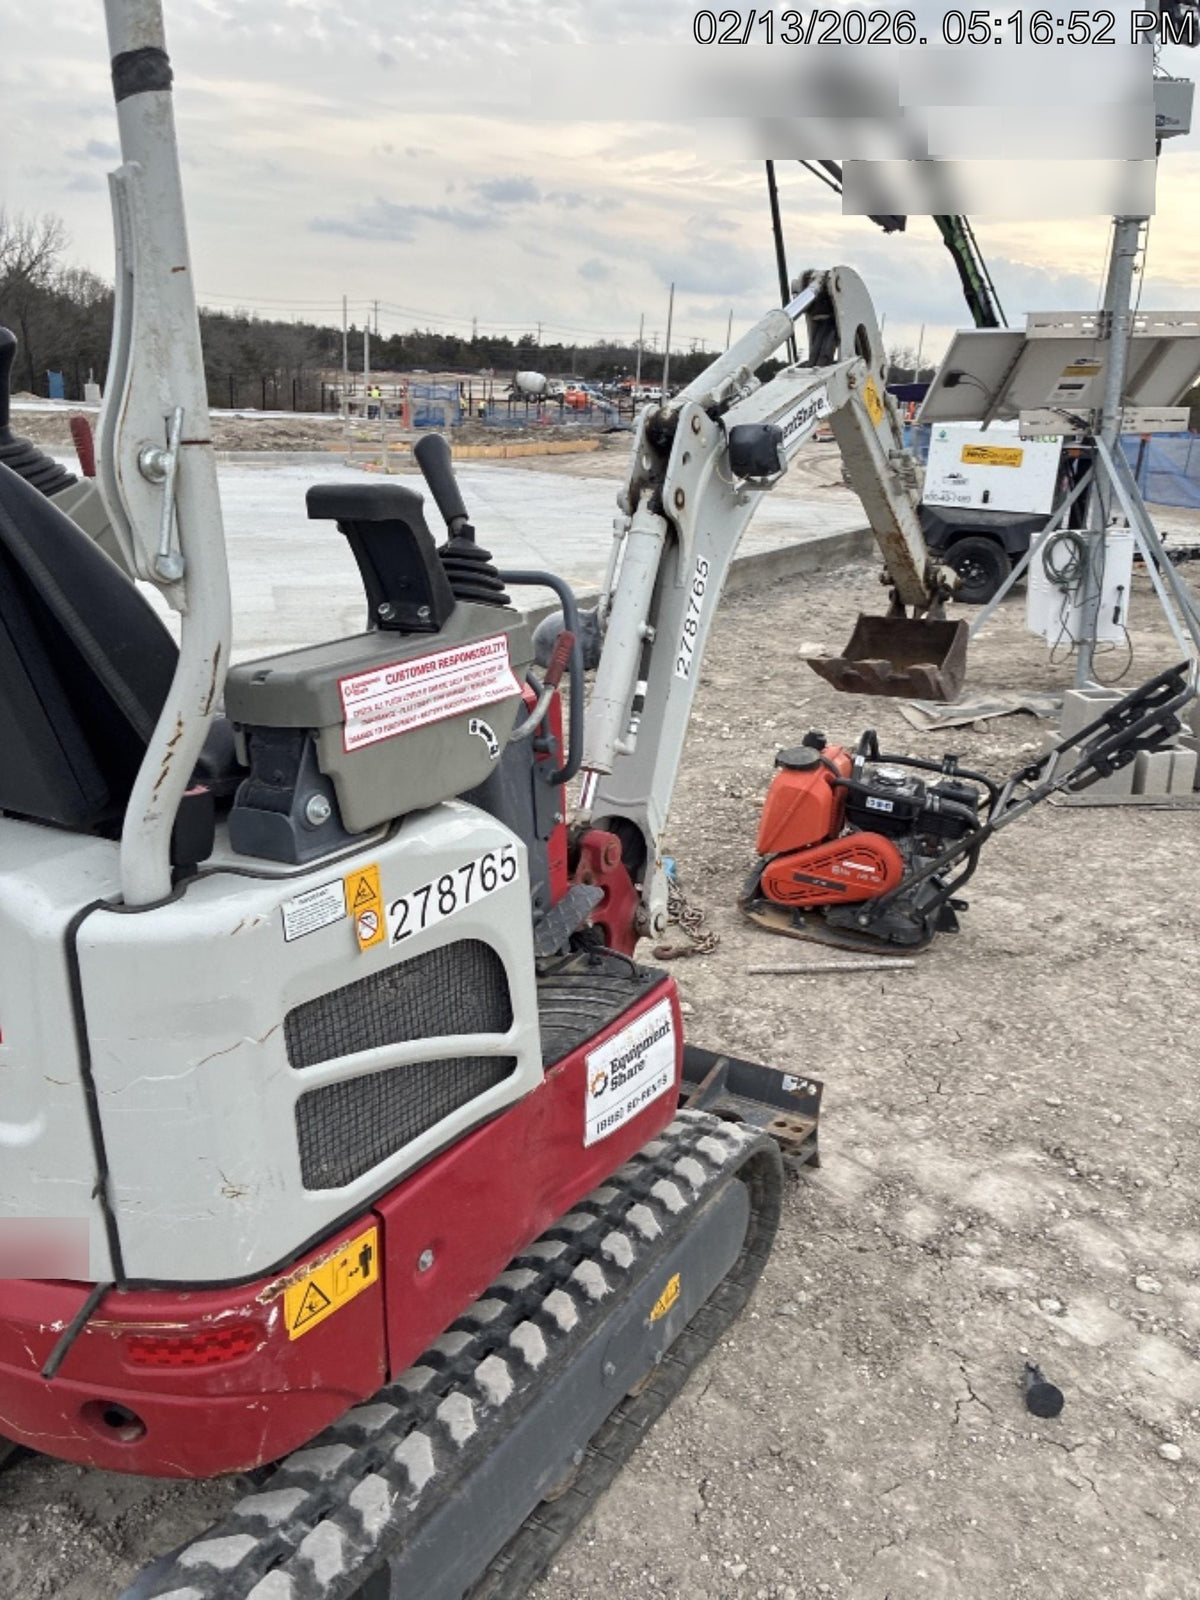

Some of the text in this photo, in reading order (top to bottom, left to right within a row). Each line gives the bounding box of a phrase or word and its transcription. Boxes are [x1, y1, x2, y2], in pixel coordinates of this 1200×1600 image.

[676, 557, 709, 676] 278765
[385, 661, 438, 685] CUSTOMER
[438, 641, 506, 669] RESPONSIBILITY
[389, 843, 517, 945] 278765
[609, 1020, 671, 1075] Equipment
[610, 1058, 646, 1091] Share
